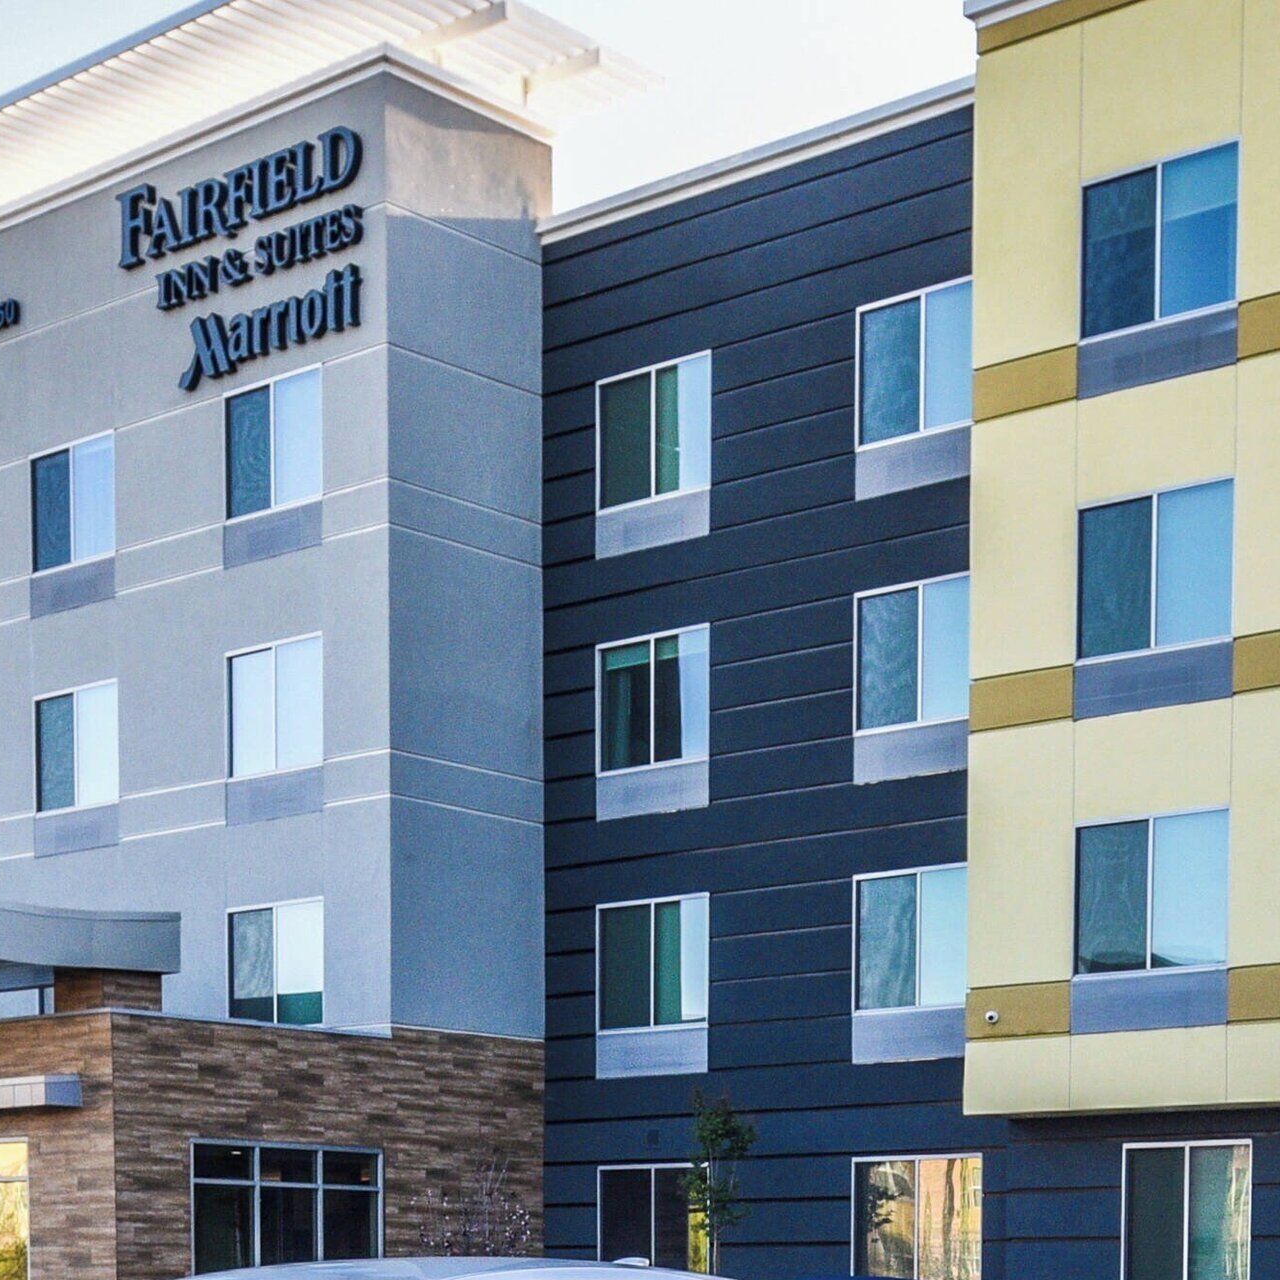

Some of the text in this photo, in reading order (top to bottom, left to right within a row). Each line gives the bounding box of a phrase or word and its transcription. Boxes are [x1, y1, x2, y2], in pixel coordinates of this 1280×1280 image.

[116, 125, 363, 270] FAIRFIELD
[156, 204, 364, 311] INN & SUITES
[179, 263, 363, 391] Marriott
